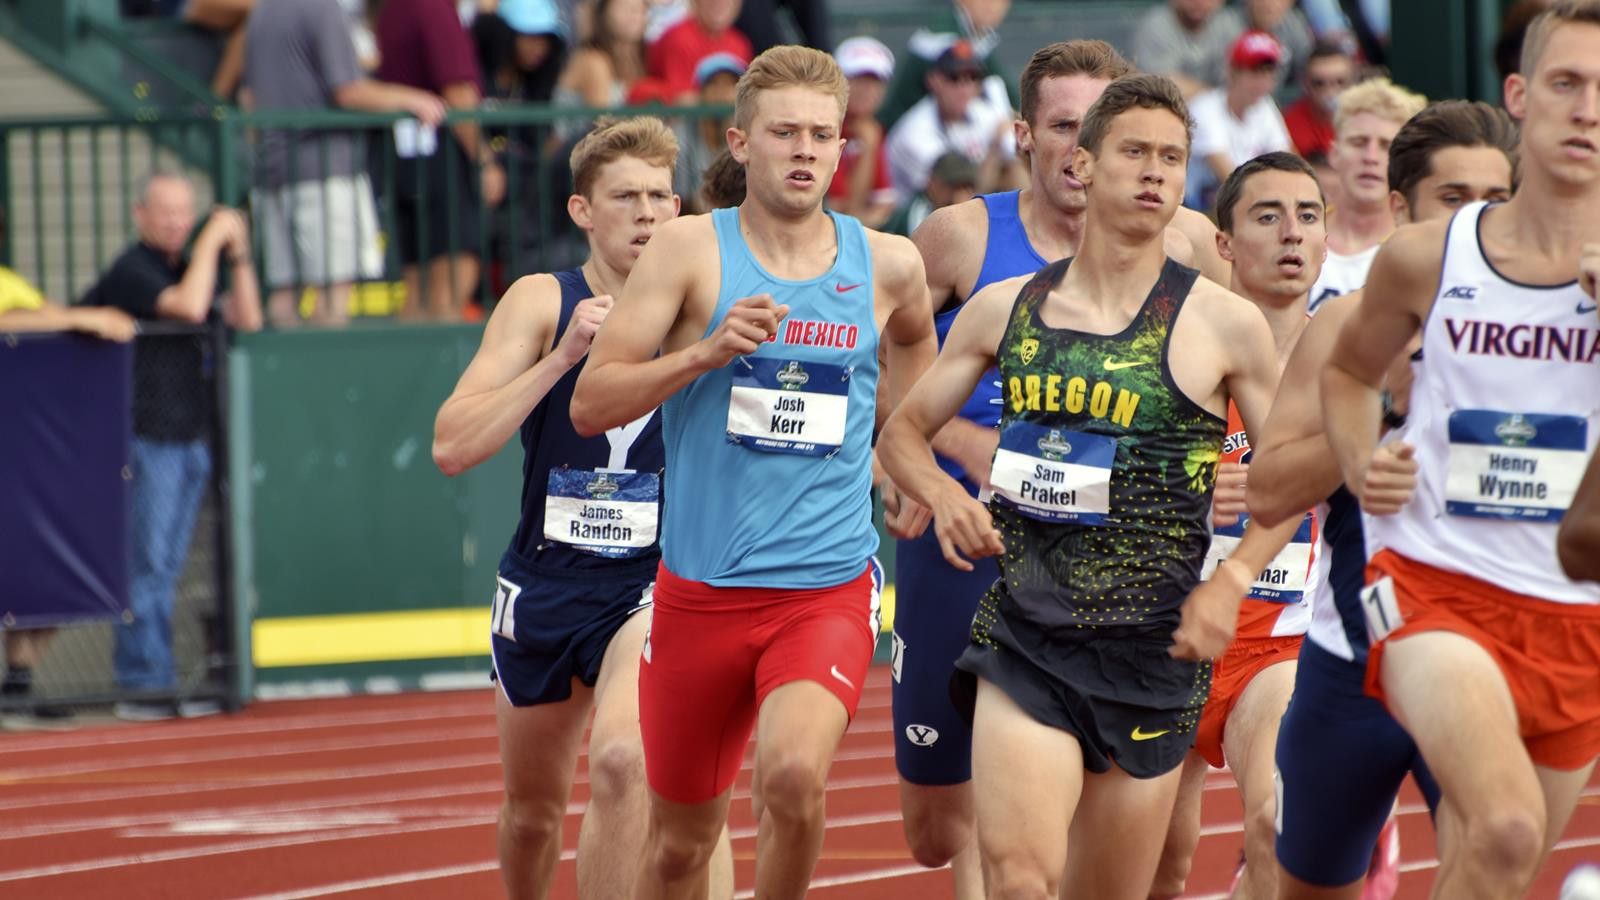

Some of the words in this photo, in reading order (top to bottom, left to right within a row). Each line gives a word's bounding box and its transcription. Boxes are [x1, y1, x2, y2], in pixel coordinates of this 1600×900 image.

[1443, 286, 1478, 299] ACC
[783, 319, 859, 350] MEXICO
[774, 396, 805, 413] Josh
[1009, 374, 1141, 428] OREGON
[770, 414, 806, 435] Kerr
[1034, 463, 1066, 484] Sam
[1489, 453, 1539, 475] Henry
[1020, 479, 1077, 506] Prakel
[1479, 474, 1548, 500] Wynne
[579, 504, 624, 521] James
[569, 520, 633, 541] Randon
[1368, 585, 1390, 632] 1
[909, 725, 933, 744] Y
